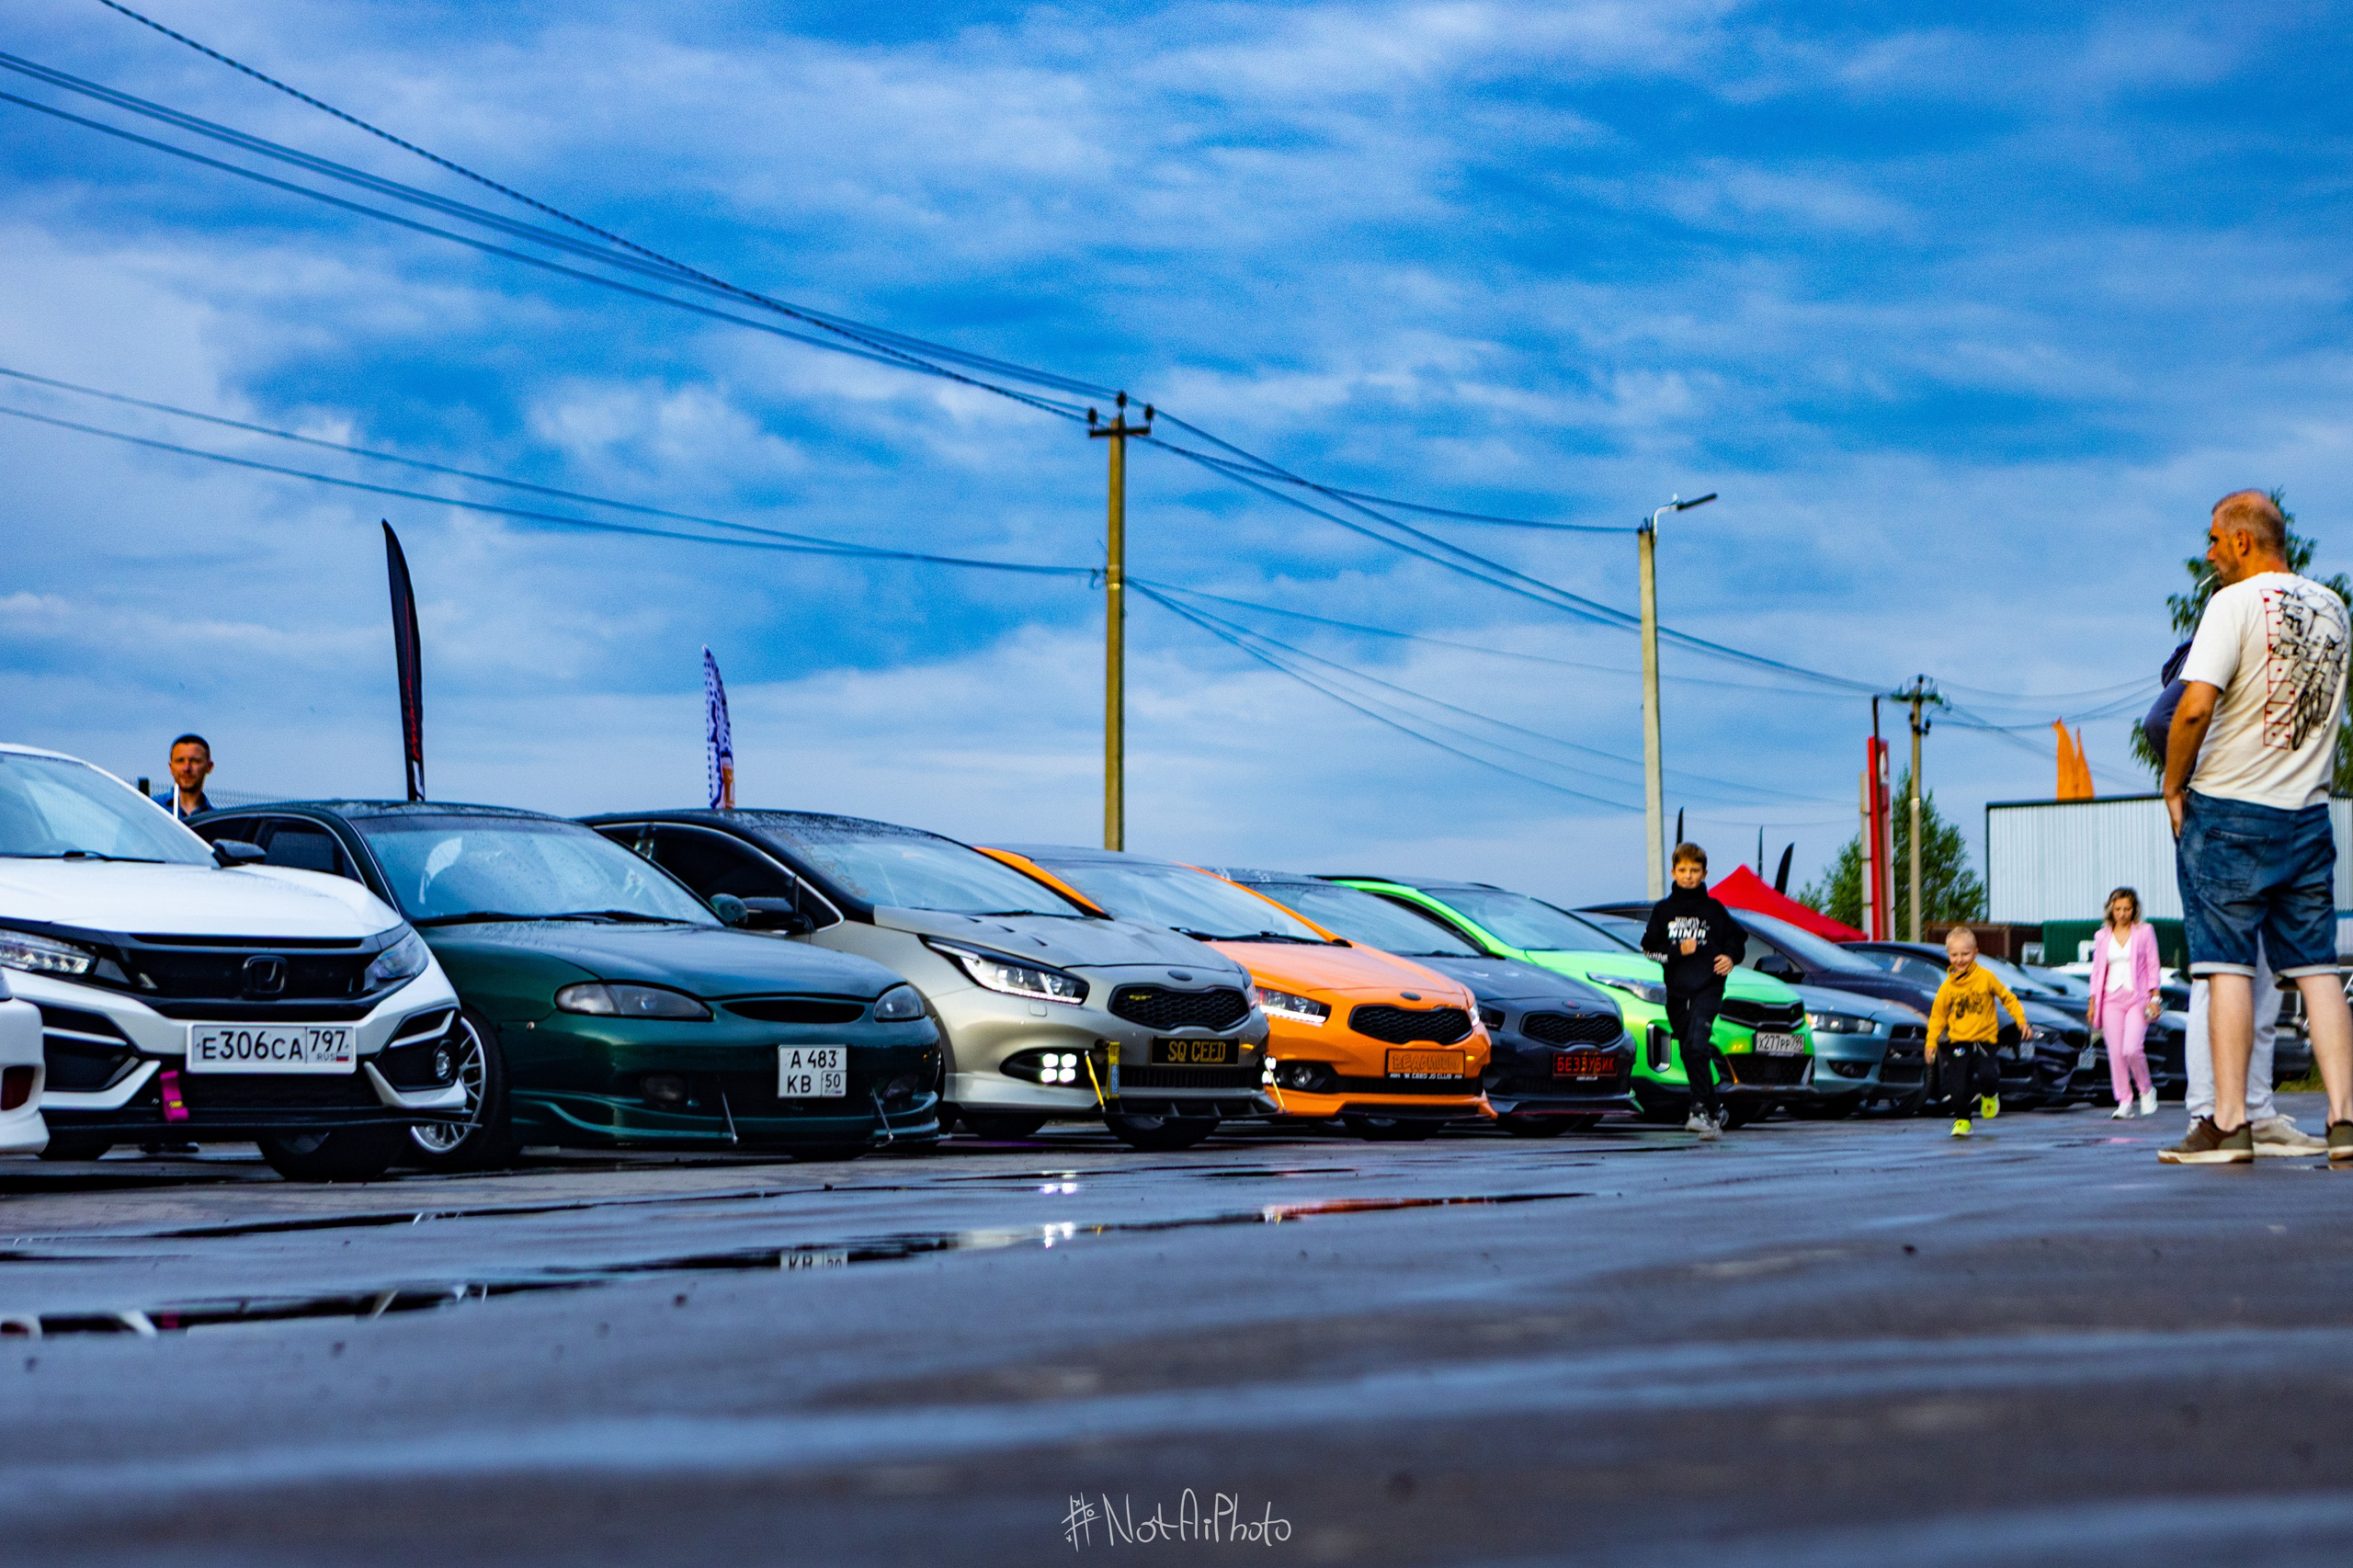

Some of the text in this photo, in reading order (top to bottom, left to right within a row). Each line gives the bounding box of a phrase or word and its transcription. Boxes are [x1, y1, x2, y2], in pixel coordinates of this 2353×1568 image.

[309, 1030, 346, 1052] 797
[807, 1050, 836, 1069] 483
[1167, 1040, 1226, 1062] SQ CEED
[1556, 1056, 1615, 1073] БЕЗЗУБИК
[825, 1074, 841, 1088] 50
